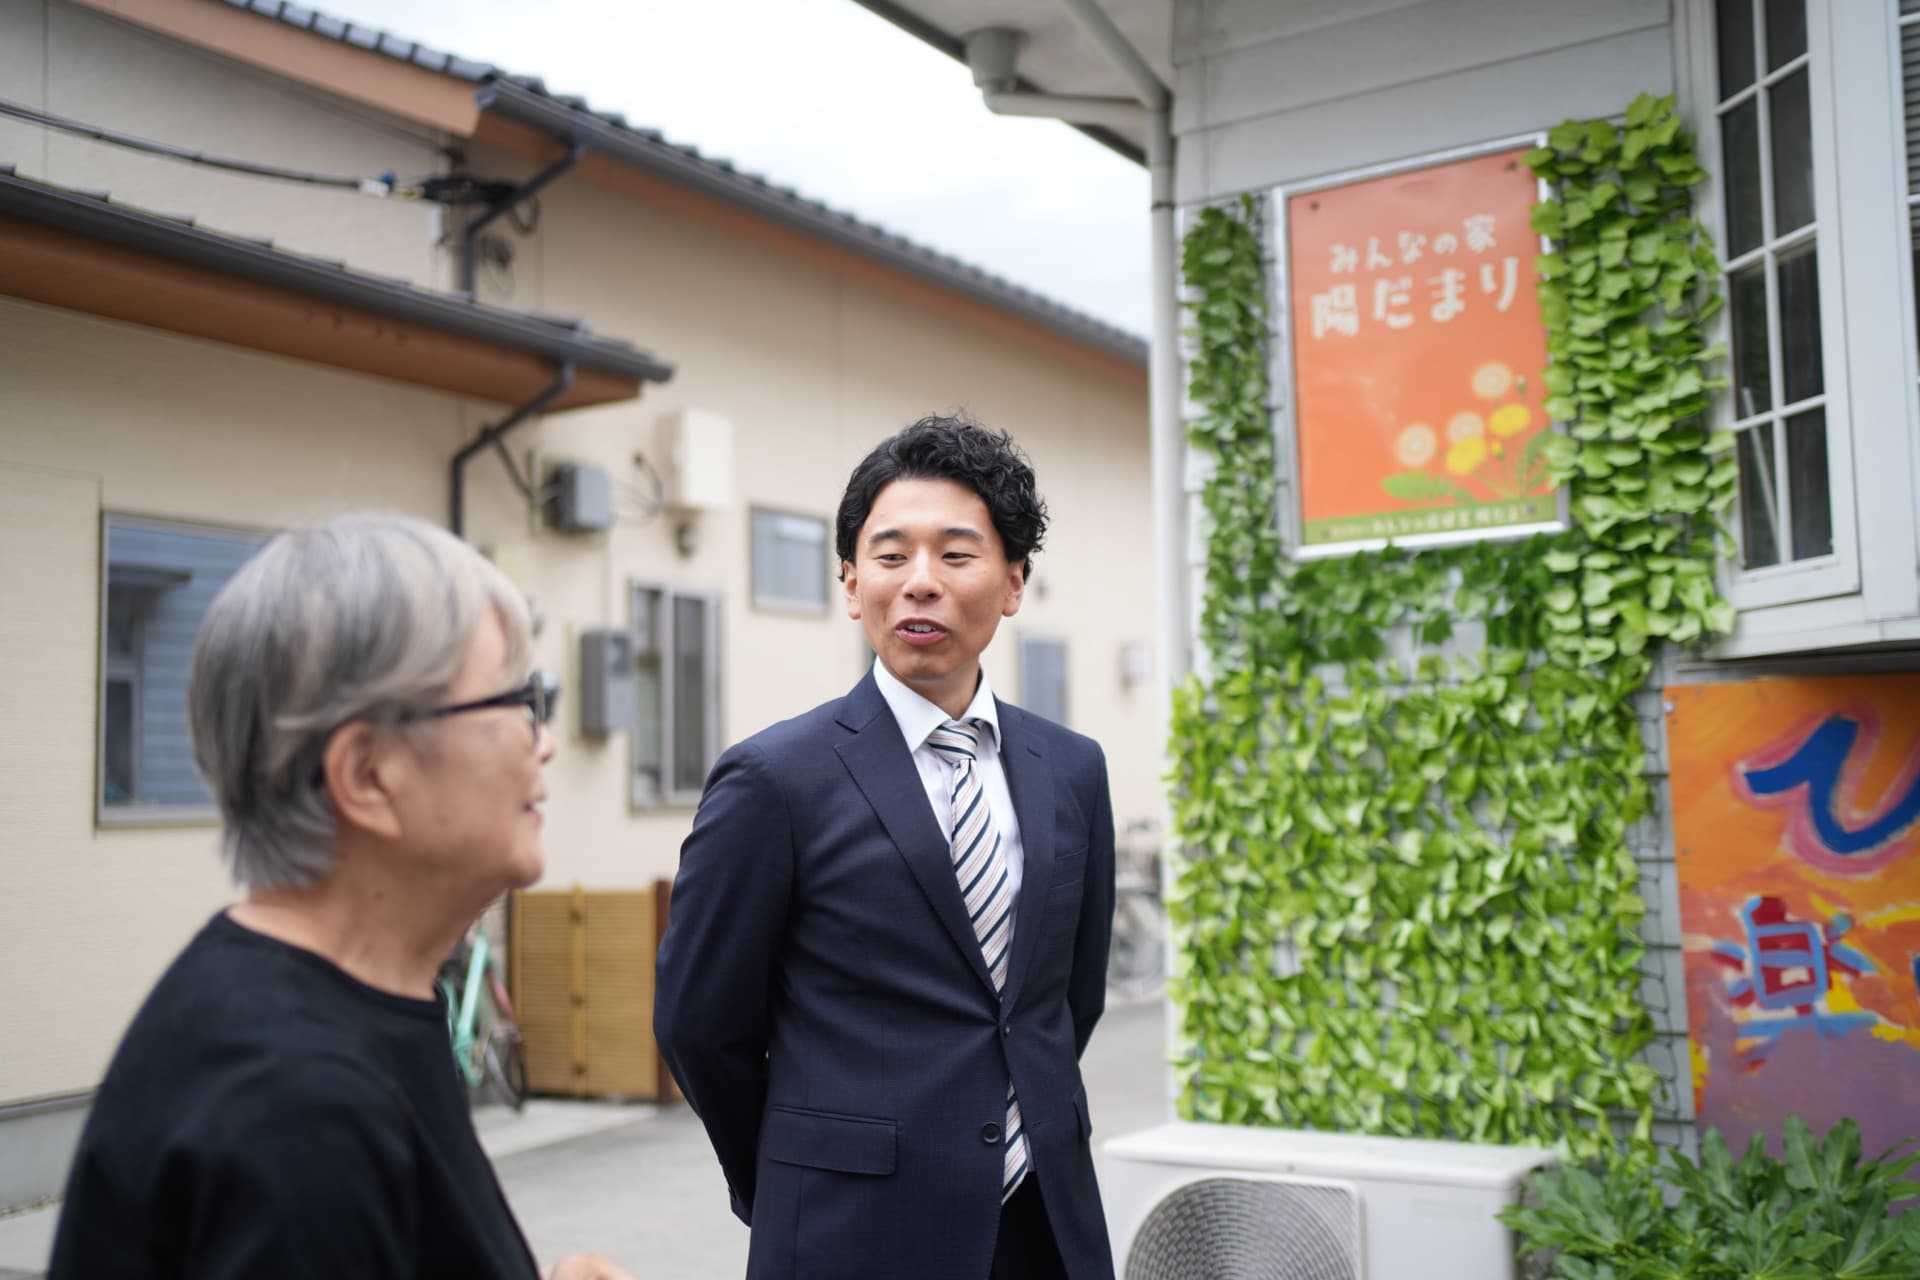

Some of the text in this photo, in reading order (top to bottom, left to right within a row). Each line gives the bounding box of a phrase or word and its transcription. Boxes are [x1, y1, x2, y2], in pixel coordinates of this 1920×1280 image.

[1329, 214, 1496, 274] みんなの家
[1312, 257, 1518, 340] 陽だまり
